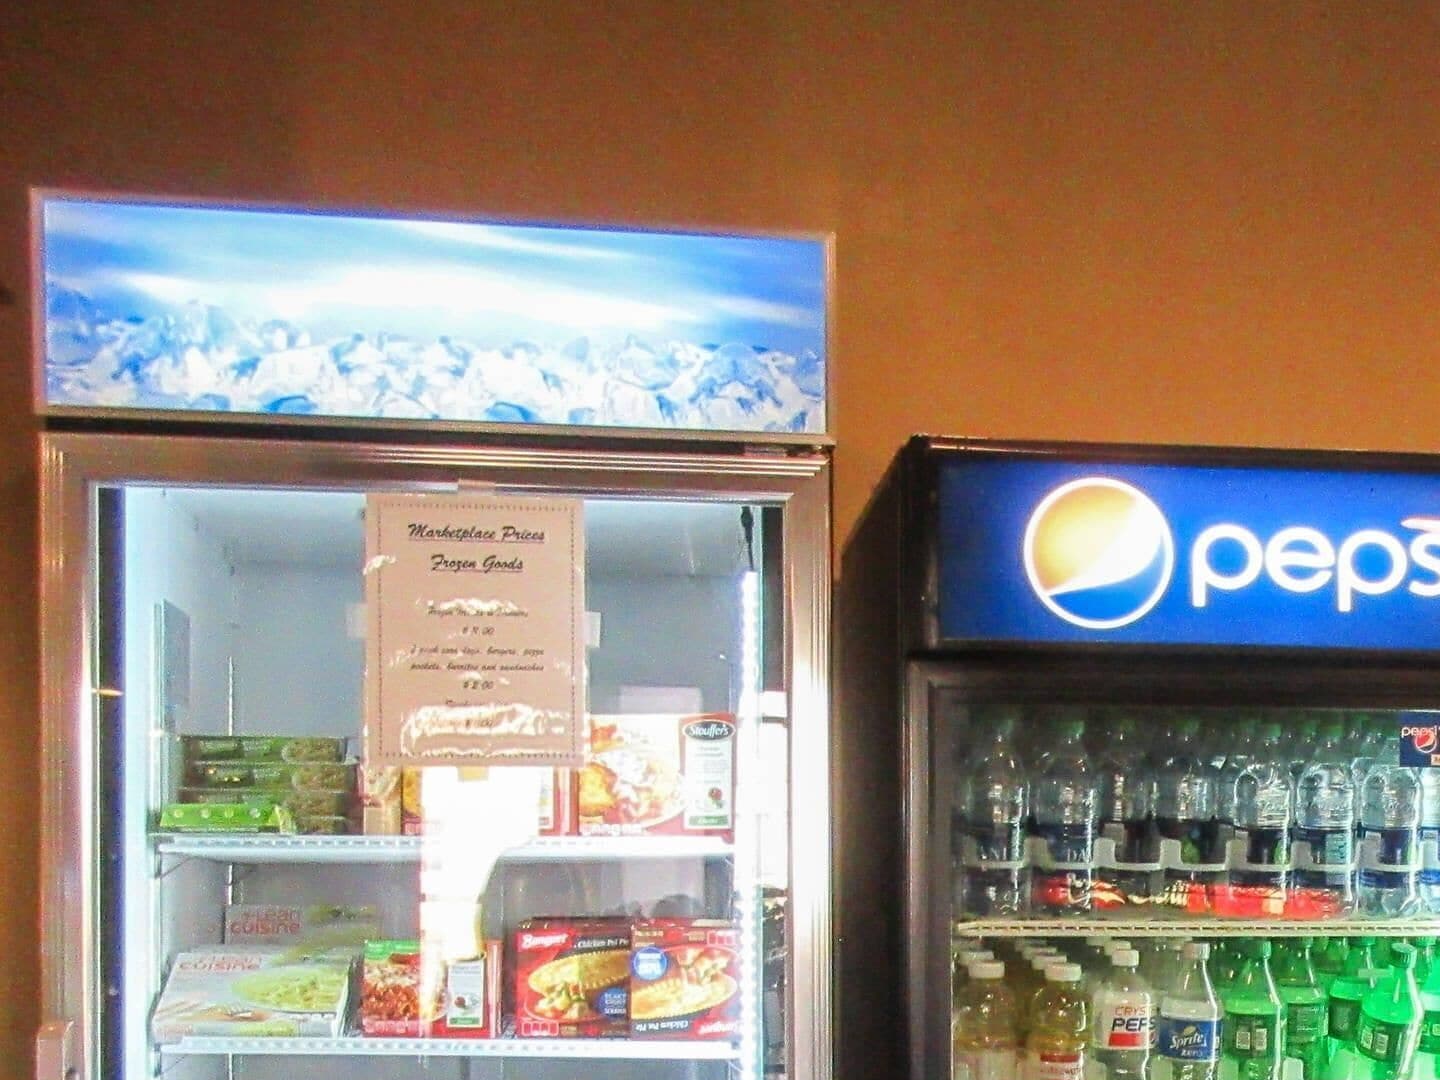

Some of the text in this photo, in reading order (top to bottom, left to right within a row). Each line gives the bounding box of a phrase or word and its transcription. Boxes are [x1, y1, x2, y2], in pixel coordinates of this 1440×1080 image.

[407, 523, 545, 542] Marketplace Prices
[430, 554, 524, 571] Frozen Goods
[689, 724, 730, 738] Stouffer's
[1401, 725, 1438, 738] pepsi
[1170, 1032, 1206, 1049] Sprite
